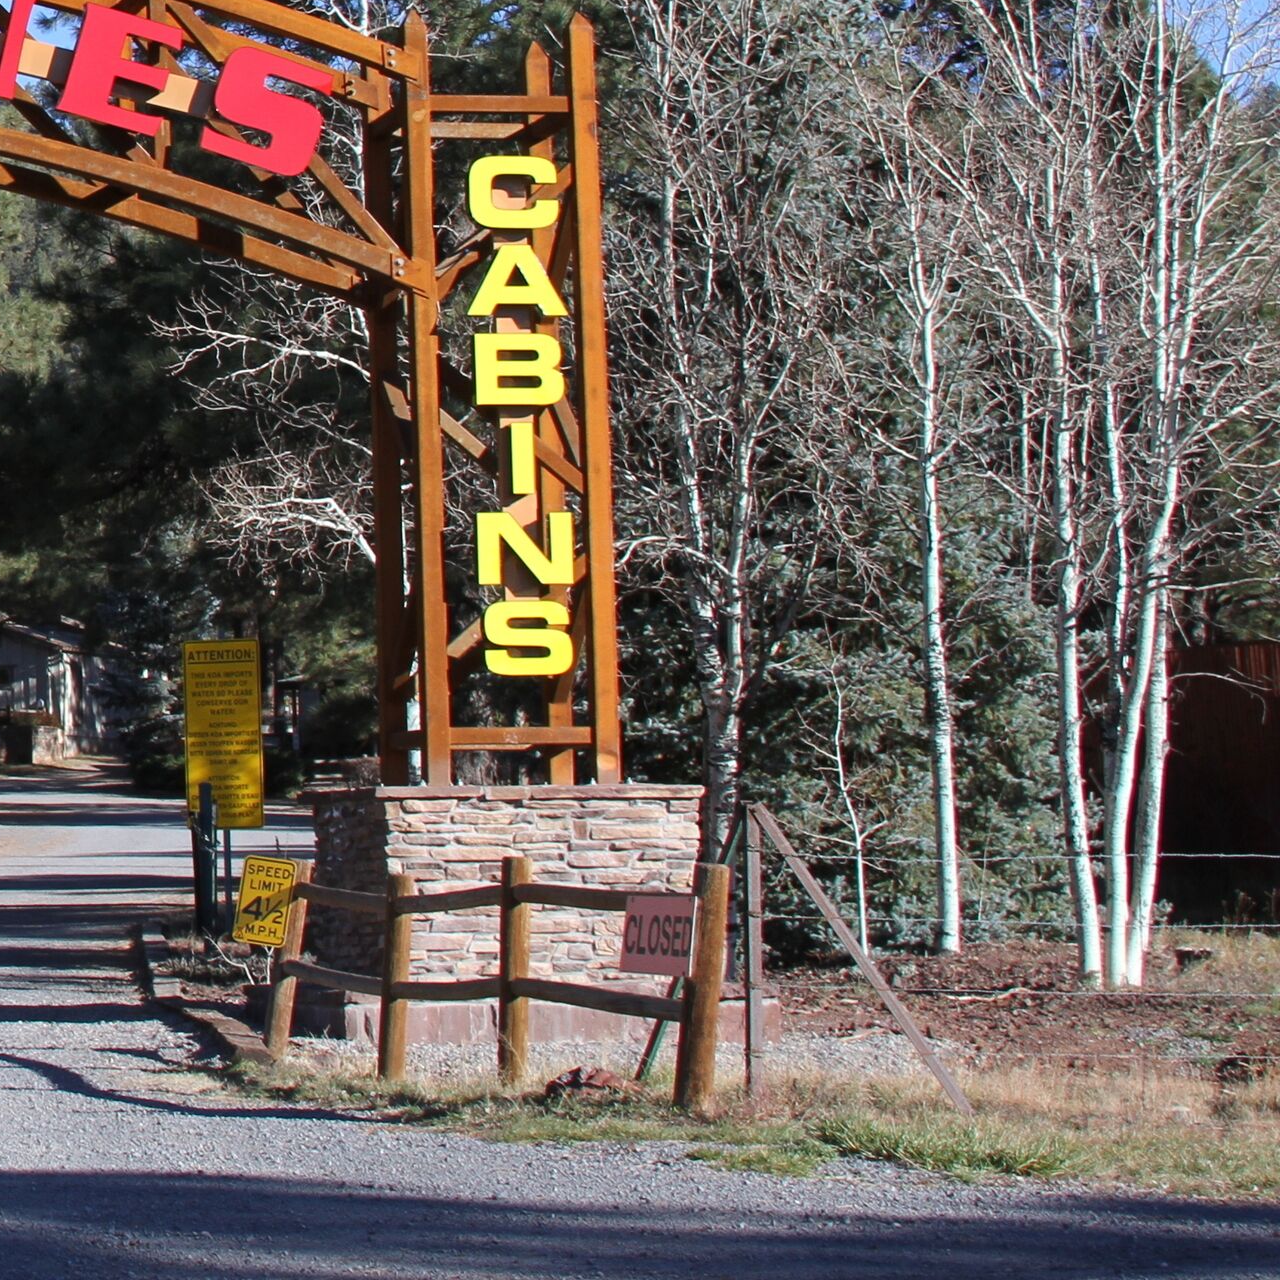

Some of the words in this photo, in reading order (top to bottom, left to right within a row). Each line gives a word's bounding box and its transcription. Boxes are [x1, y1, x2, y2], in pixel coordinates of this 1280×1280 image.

[467, 155, 575, 677] CABINS
[187, 648, 256, 661] ATTENTION:
[247, 864, 291, 879] SPEED
[249, 879, 284, 893] LIMIT
[624, 914, 693, 957] CLOSED
